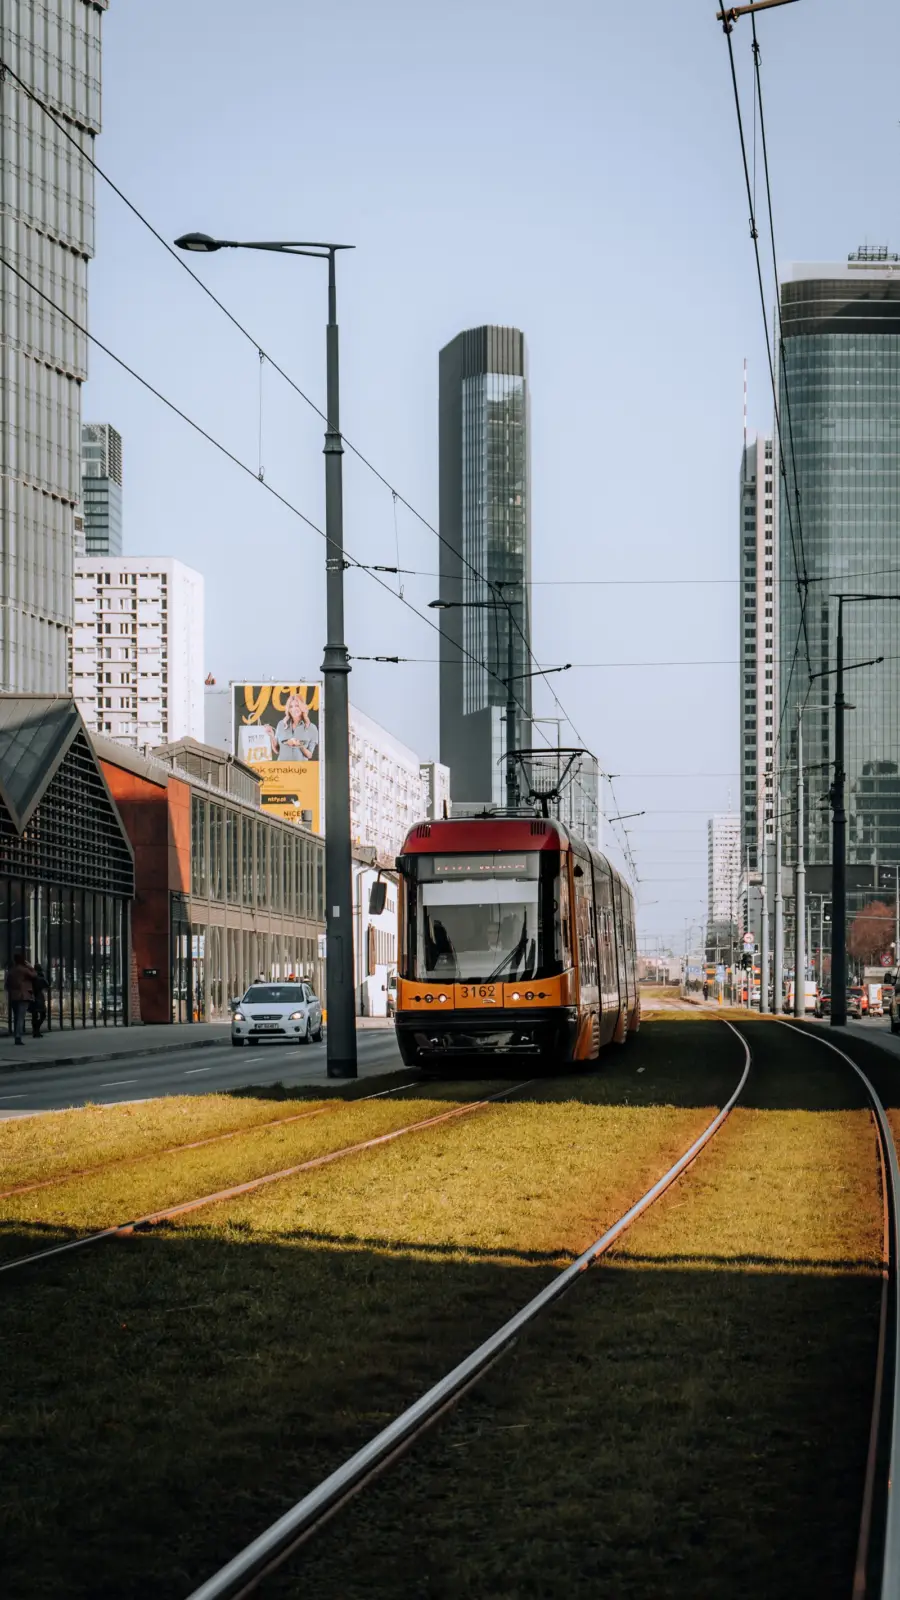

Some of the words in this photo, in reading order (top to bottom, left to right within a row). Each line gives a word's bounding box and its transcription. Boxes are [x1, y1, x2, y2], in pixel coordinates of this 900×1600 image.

[242, 685, 320, 725] you
[268, 765, 308, 775] smakuje
[460, 985, 496, 998] 3162
